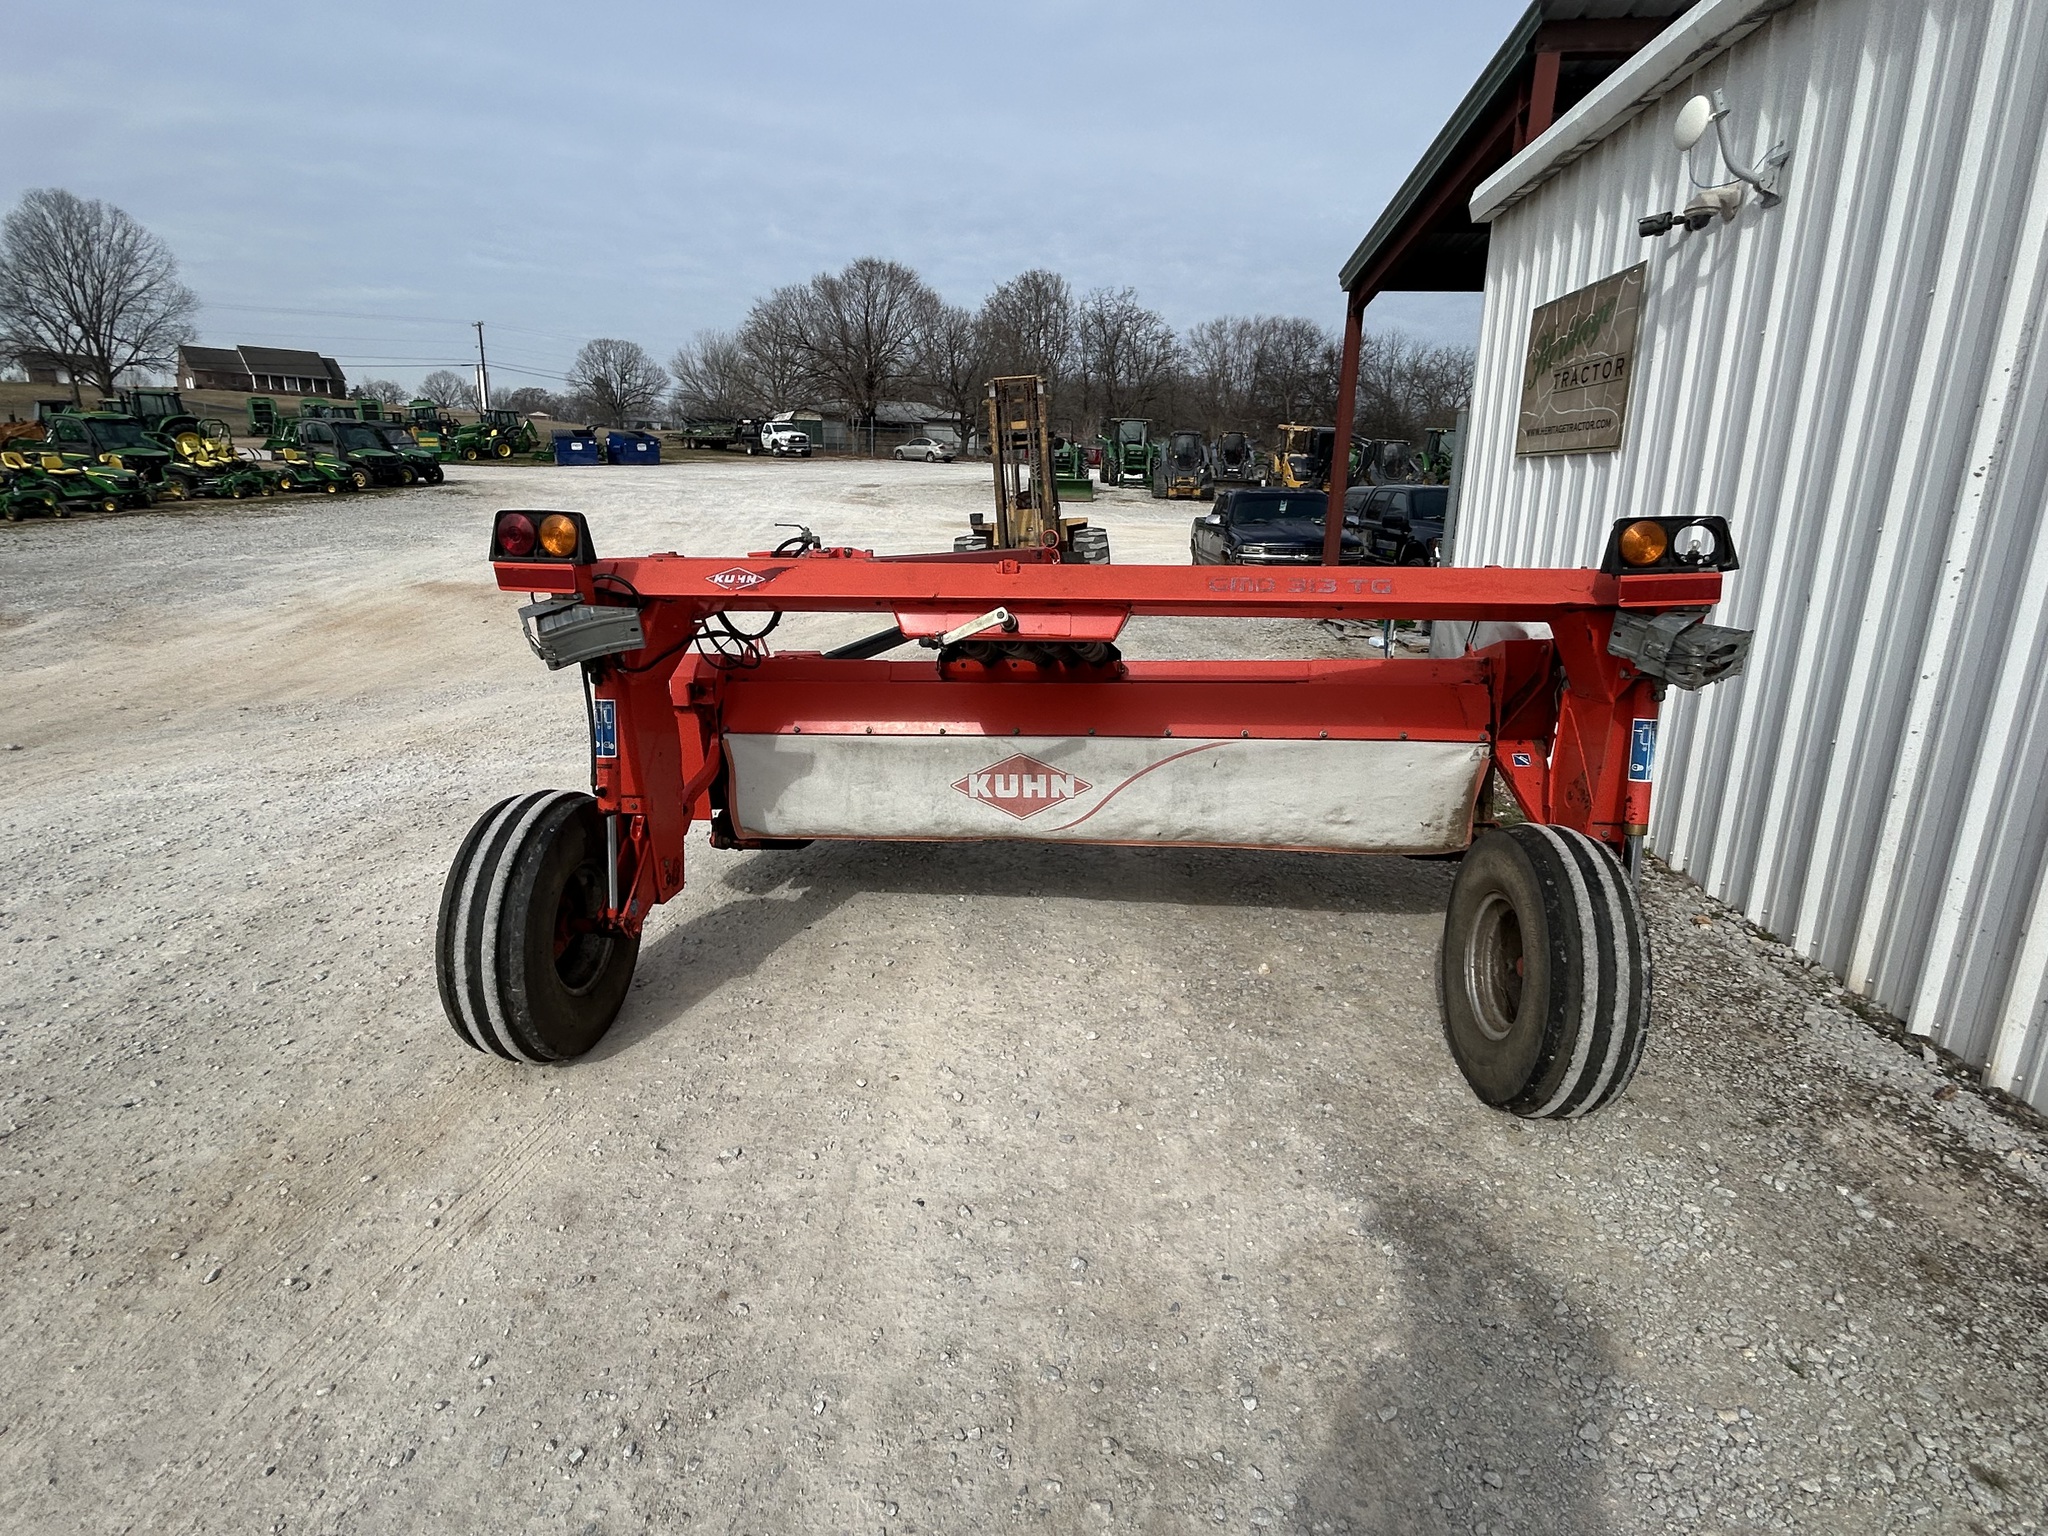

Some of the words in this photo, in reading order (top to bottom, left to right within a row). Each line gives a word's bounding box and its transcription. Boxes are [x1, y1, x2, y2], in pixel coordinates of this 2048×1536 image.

[1553, 358, 1625, 389] TRACTOR
[1287, 577, 1337, 593] 313
[1347, 578, 1392, 594] TG
[968, 774, 1075, 798] KUHN
